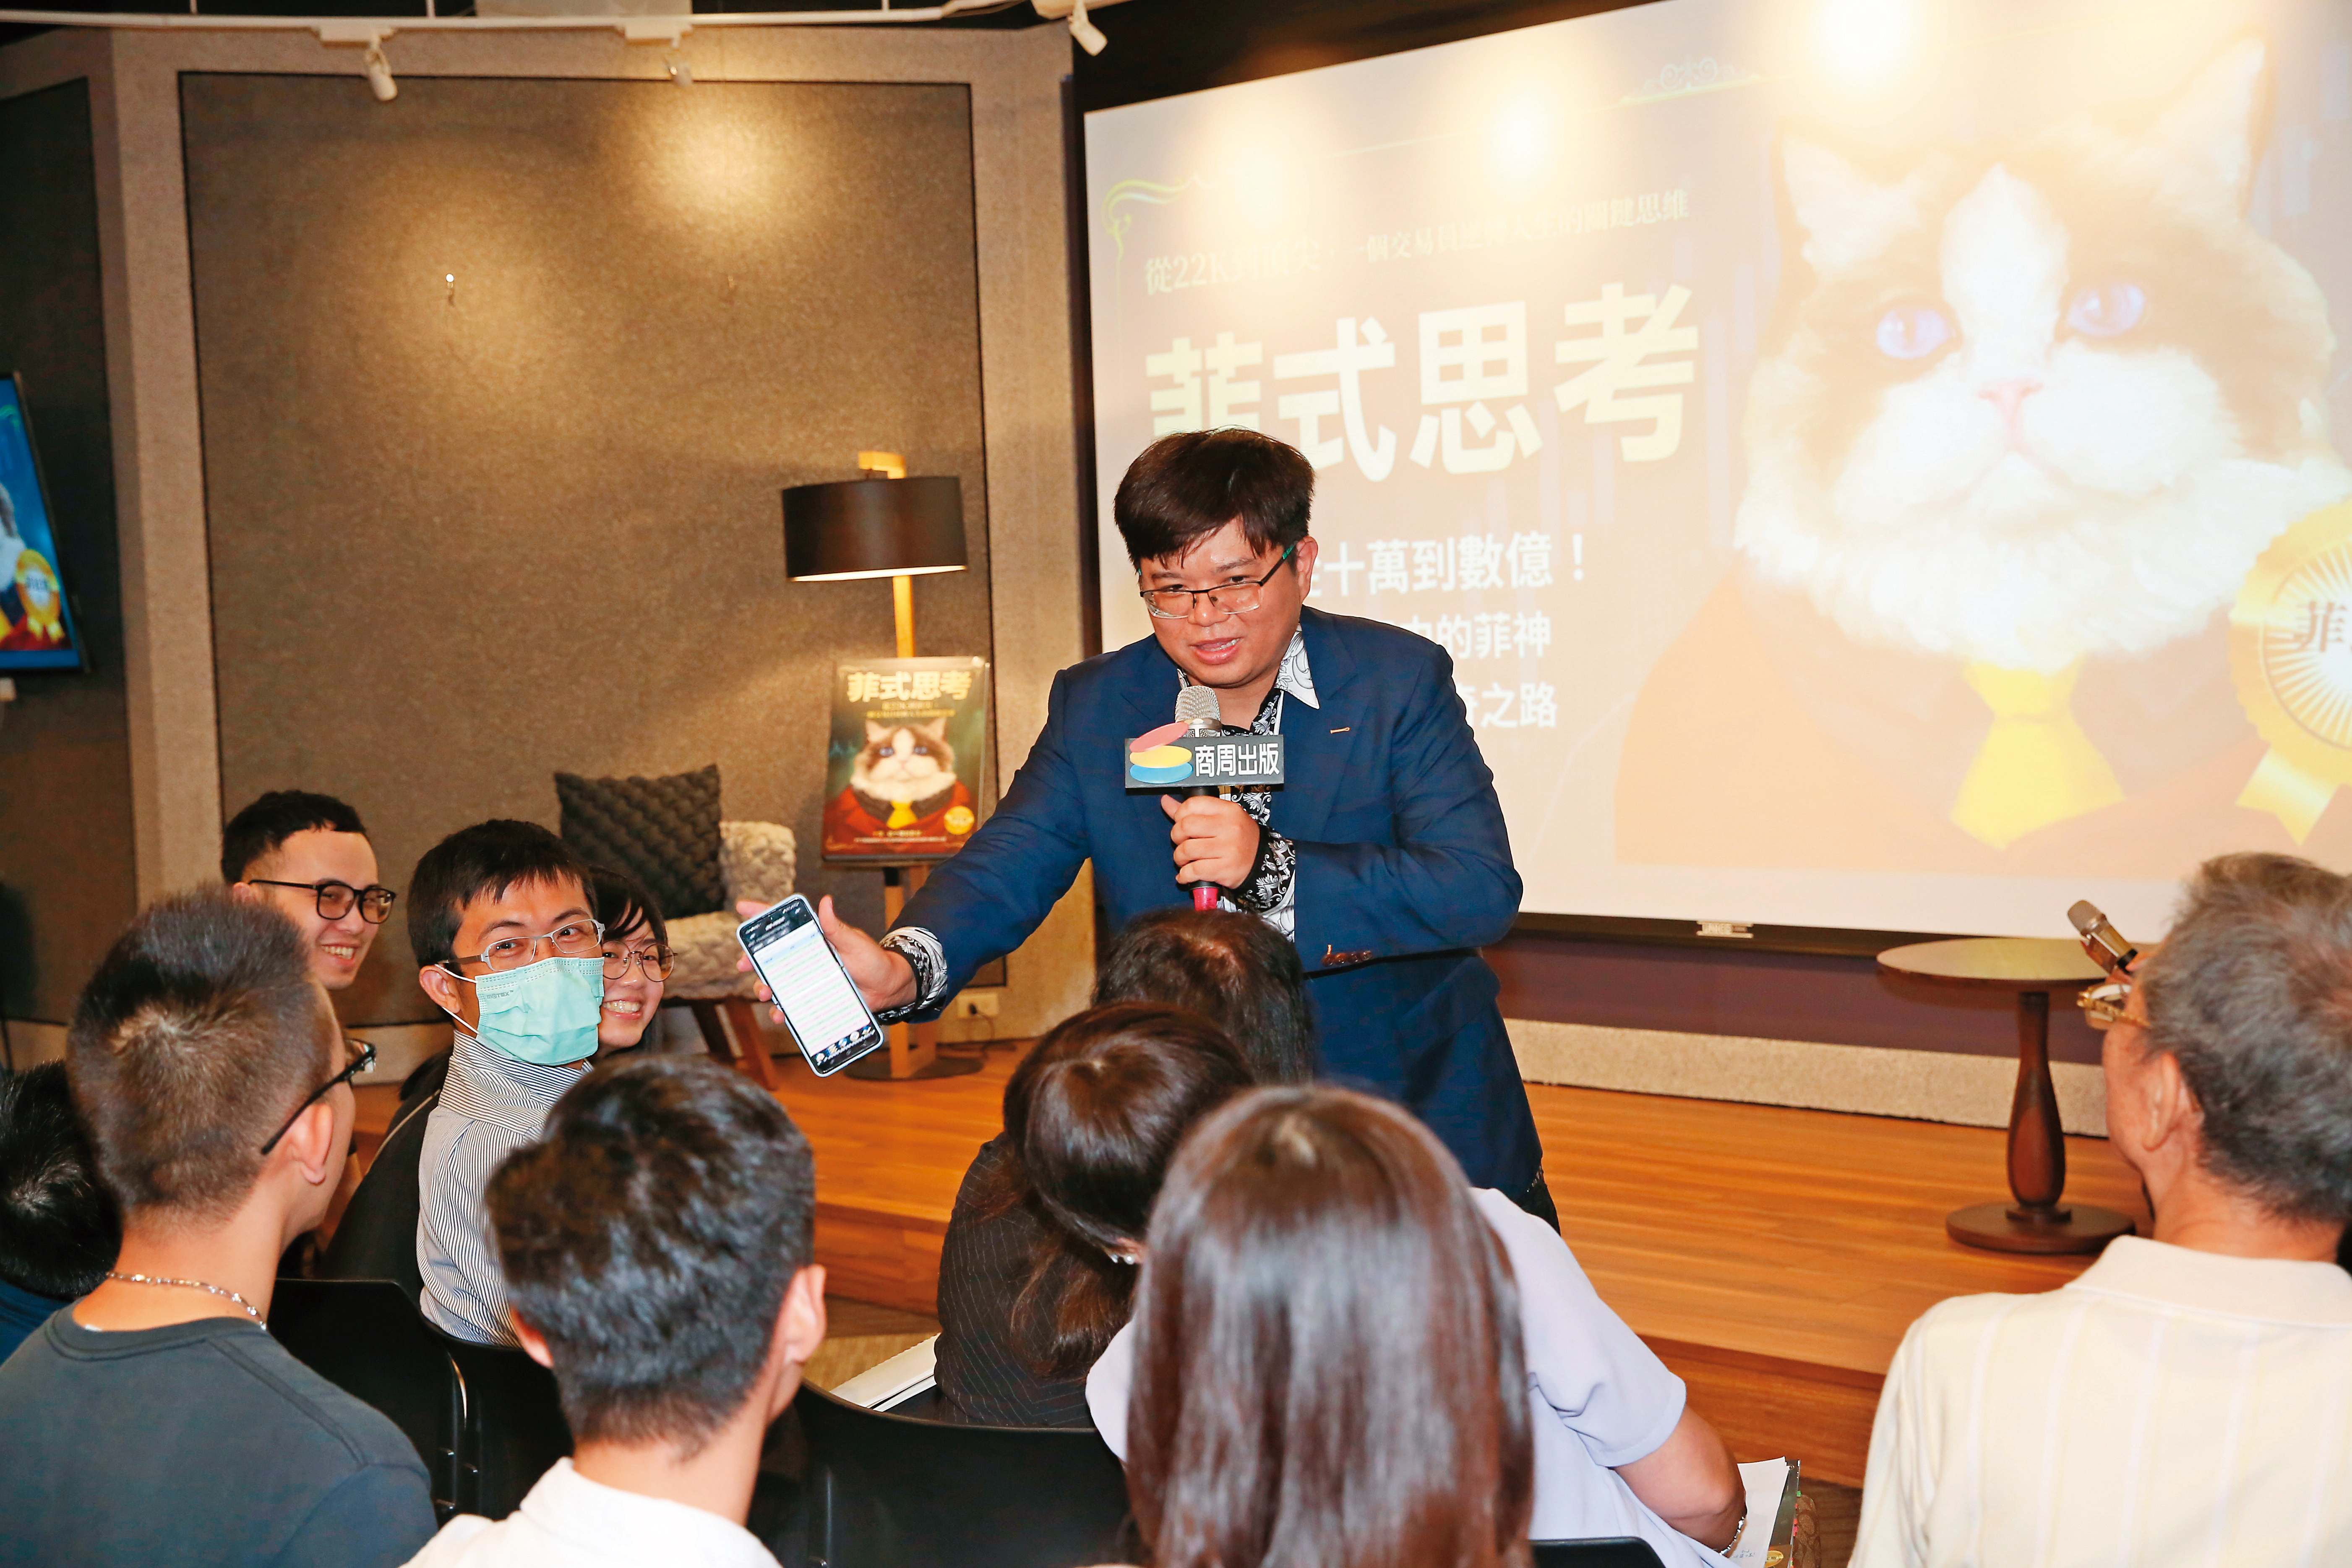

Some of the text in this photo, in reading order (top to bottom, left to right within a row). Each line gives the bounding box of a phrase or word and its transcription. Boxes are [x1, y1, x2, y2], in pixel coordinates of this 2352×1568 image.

[1145, 282, 1698, 482] 菲式思考
[1308, 530, 1585, 598] 十萬到數億！
[1386, 610, 1551, 659] 的菲神
[847, 670, 972, 702] 菲式思考
[1195, 742, 1280, 778] 商周出版
